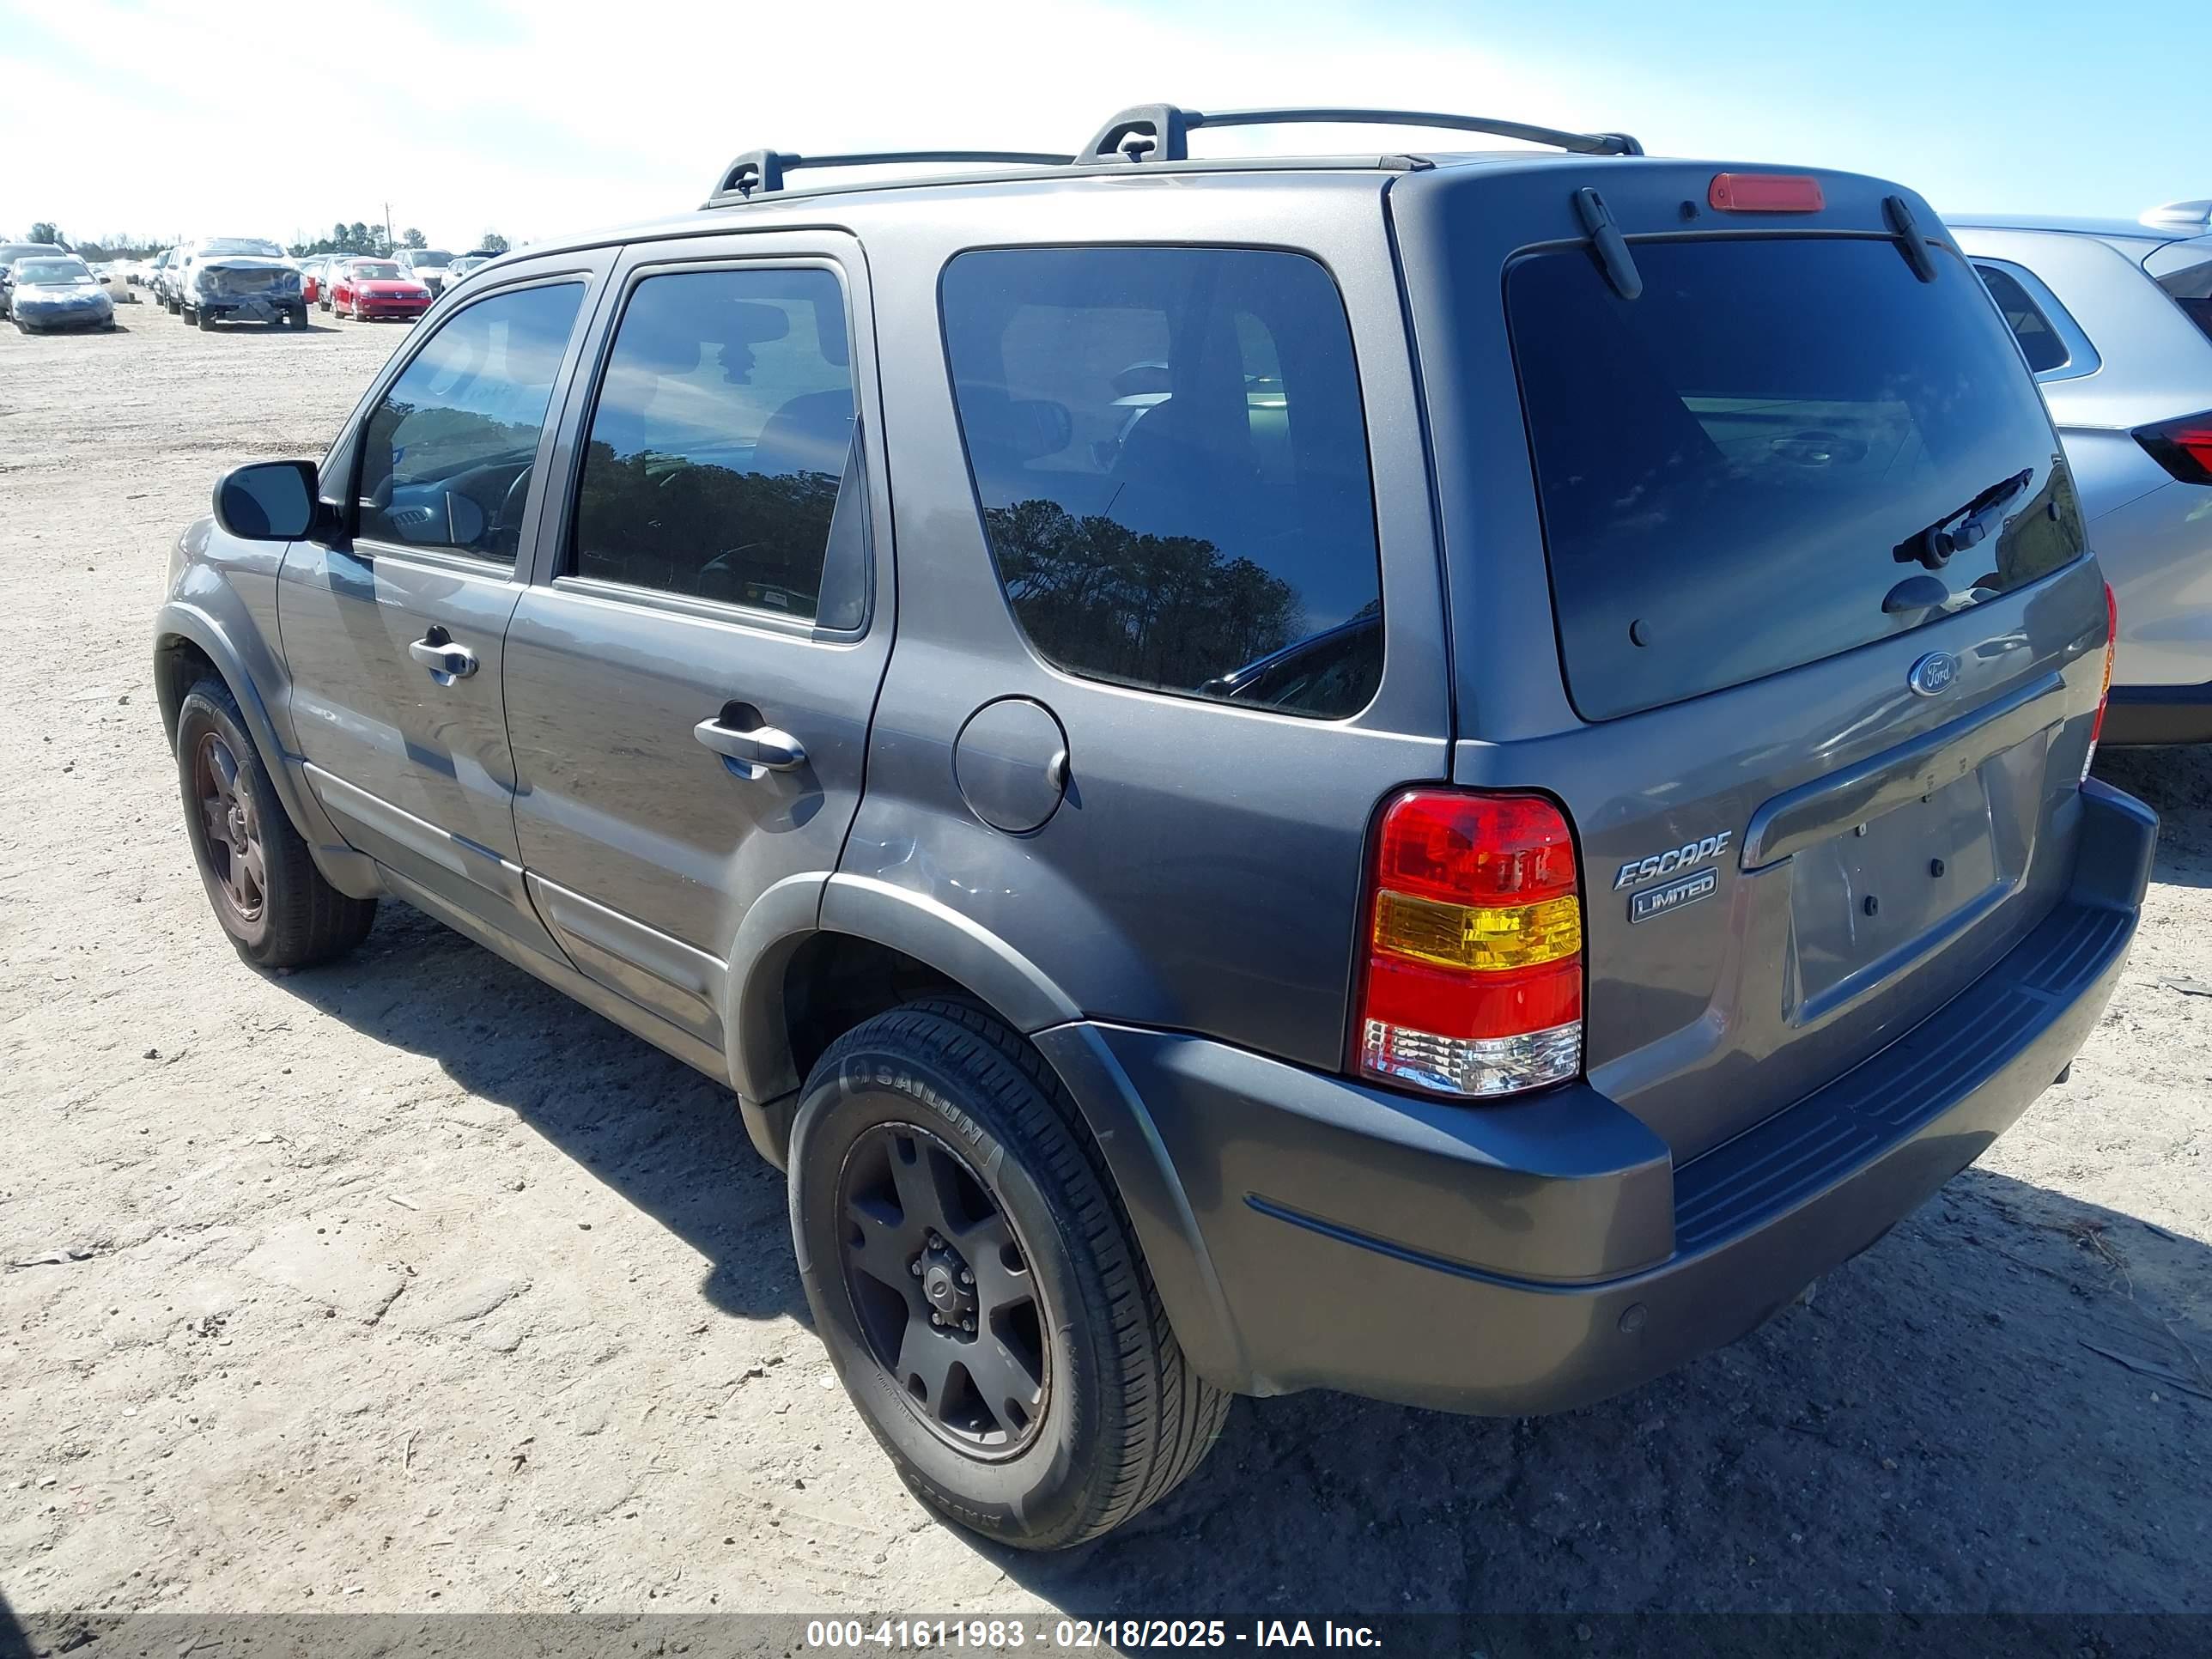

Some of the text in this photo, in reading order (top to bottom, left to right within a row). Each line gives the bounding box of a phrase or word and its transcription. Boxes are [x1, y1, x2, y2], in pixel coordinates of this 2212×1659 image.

[1927, 659, 1951, 687] Ford
[1613, 830, 1732, 890] ESCAPE
[1637, 874, 1716, 915] LIMITED
[875, 1064, 984, 1146] SAILUN
